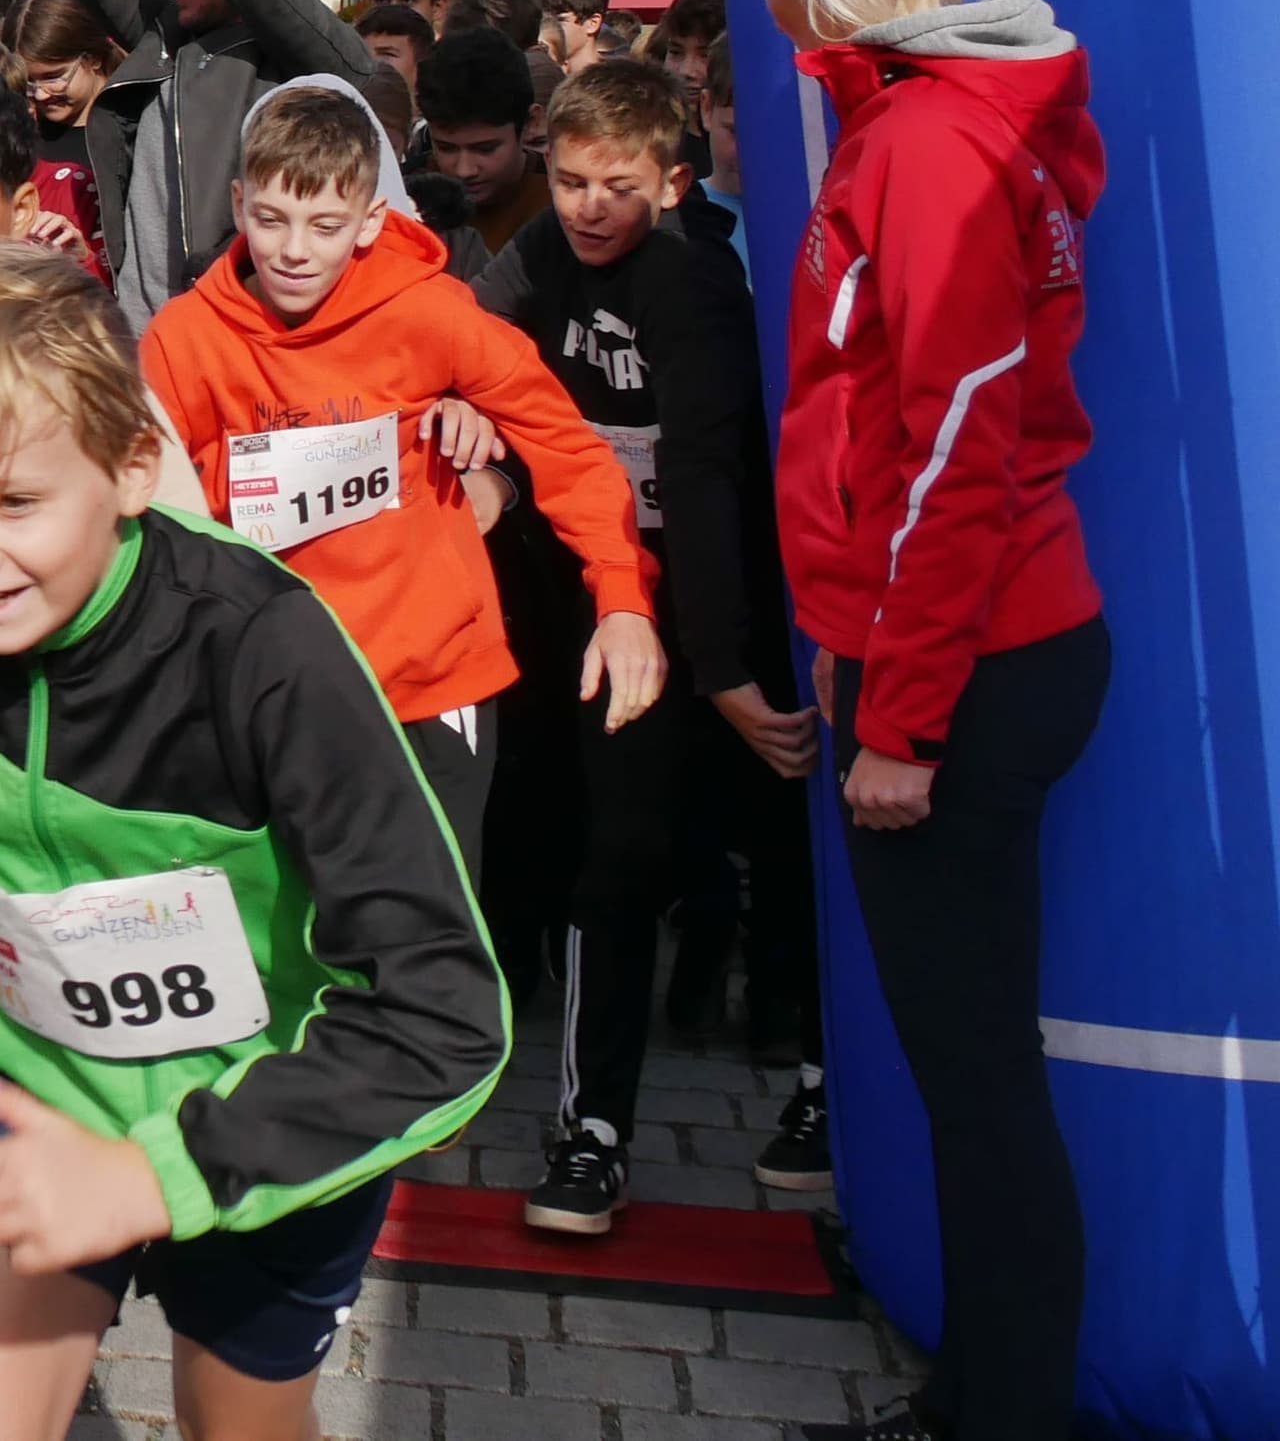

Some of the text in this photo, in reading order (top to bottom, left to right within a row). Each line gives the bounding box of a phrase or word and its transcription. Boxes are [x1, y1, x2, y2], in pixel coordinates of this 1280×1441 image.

[305, 445, 358, 462] GUNZEN
[237, 502, 275, 516] REMA
[290, 466, 389, 525] 1196
[52, 916, 150, 943] GUNZEN
[112, 916, 205, 945] HAUSEN
[61, 964, 216, 1028] 998
